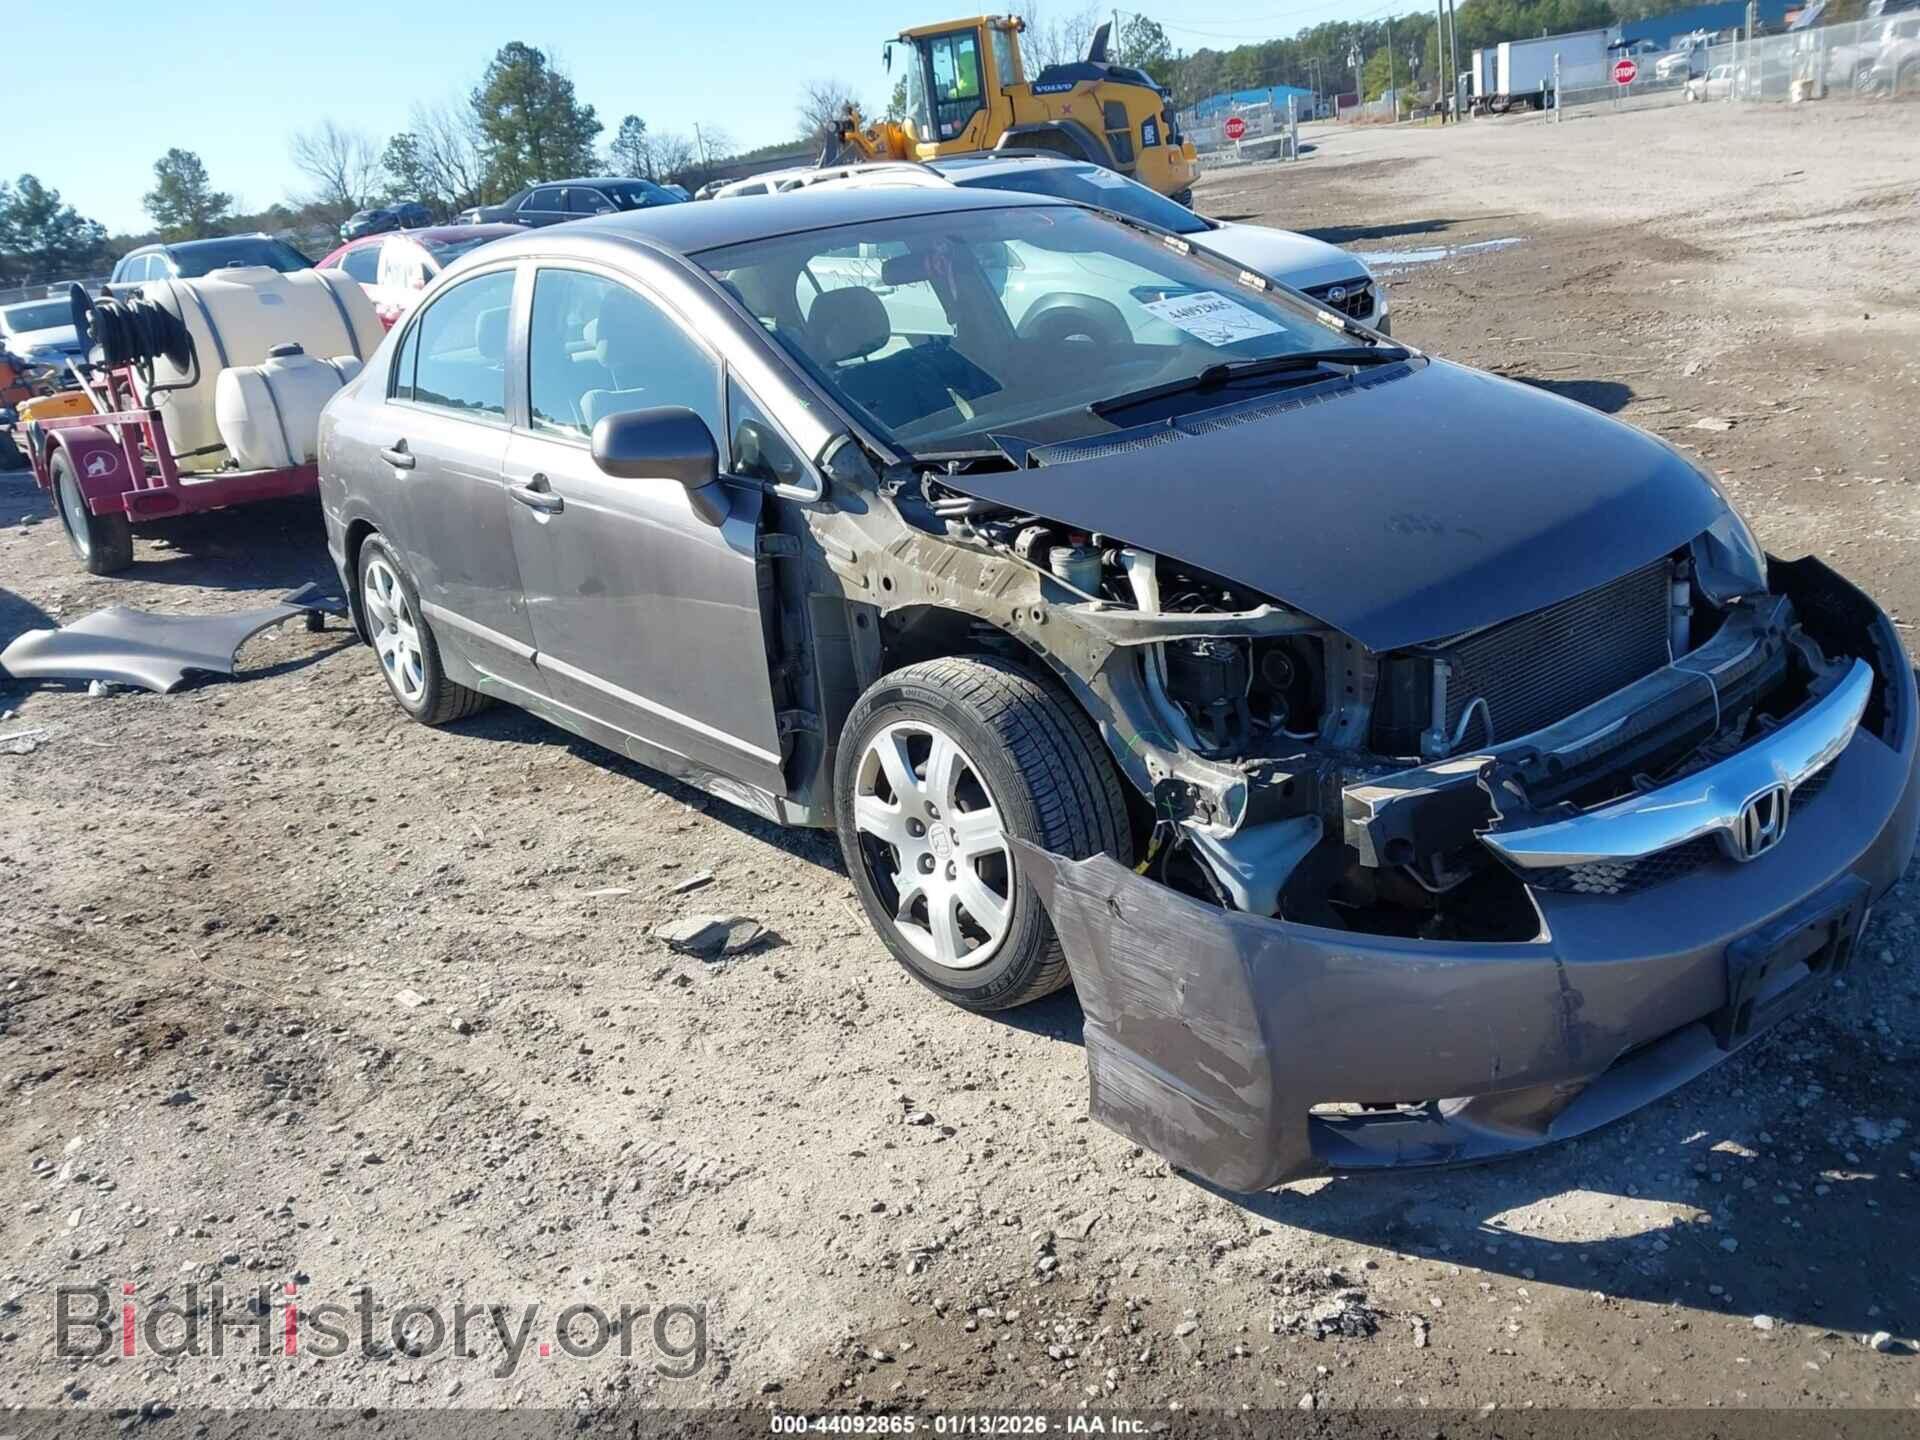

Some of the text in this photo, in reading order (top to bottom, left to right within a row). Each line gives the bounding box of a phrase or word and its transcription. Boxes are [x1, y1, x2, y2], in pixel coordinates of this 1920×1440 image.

[1615, 66, 1636, 78] STOP
[1035, 83, 1073, 93] VOLVO
[1226, 123, 1244, 134] STOP
